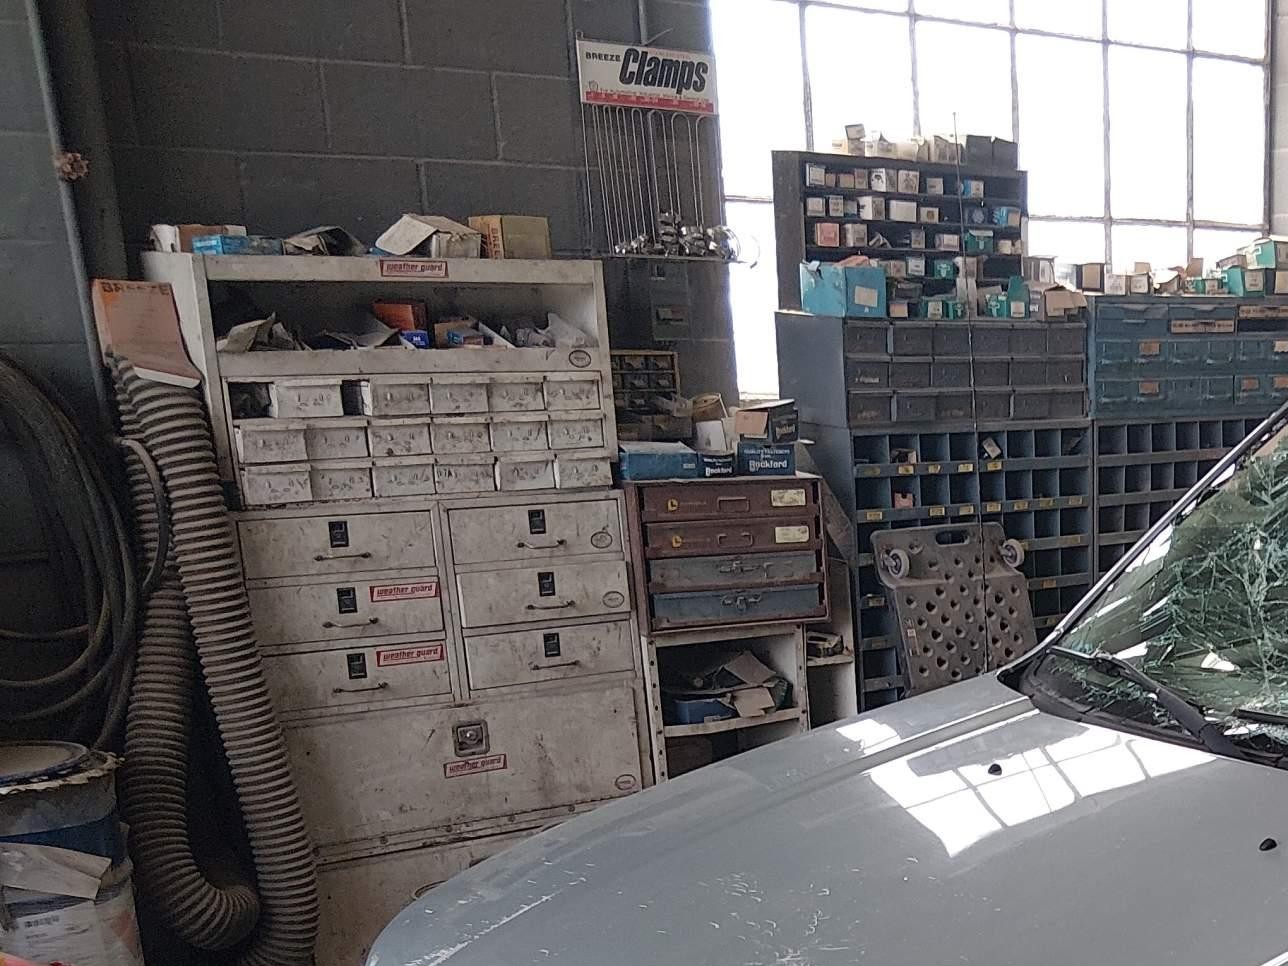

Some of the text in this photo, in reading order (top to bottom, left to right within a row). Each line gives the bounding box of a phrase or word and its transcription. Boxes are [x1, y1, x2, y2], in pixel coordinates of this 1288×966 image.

[585, 51, 621, 62] BREEZE
[619, 47, 709, 95] Clamps
[386, 261, 444, 273] weather guard
[377, 584, 433, 596] weather guard
[383, 647, 439, 661] weather guard
